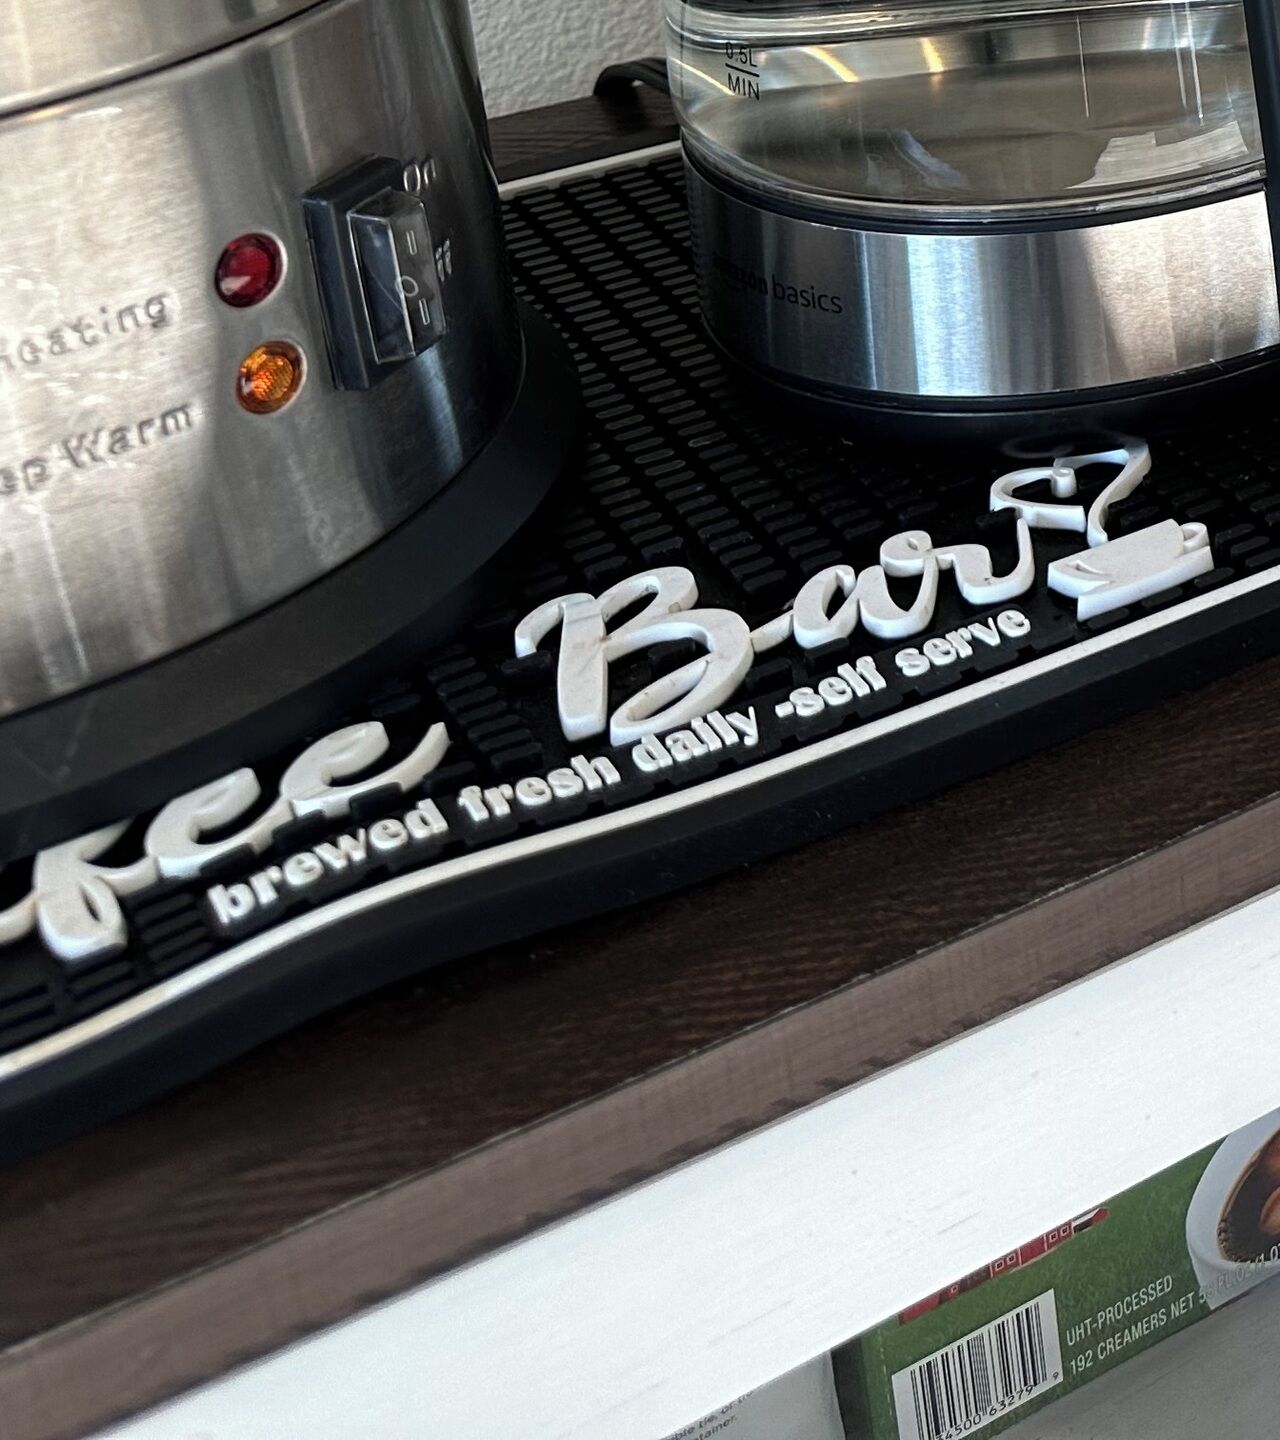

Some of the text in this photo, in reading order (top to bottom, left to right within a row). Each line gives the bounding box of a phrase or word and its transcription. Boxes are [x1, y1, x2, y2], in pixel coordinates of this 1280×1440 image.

[727, 72, 760, 100] MIN
[771, 273, 844, 315] basics
[60, 403, 193, 469] Warm
[206, 797, 451, 926] brewed
[456, 752, 622, 823] fresh
[631, 703, 761, 776] daily
[894, 605, 1032, 679] serve
[1066, 1274, 1174, 1347] UHT-PROCESSED
[1070, 1349, 1094, 1376] 192
[1096, 1307, 1168, 1361] CREAMERS
[1170, 1291, 1195, 1320] NET
[988, 1383, 1036, 1417] 63279
[1052, 1370, 1060, 1382] 9
